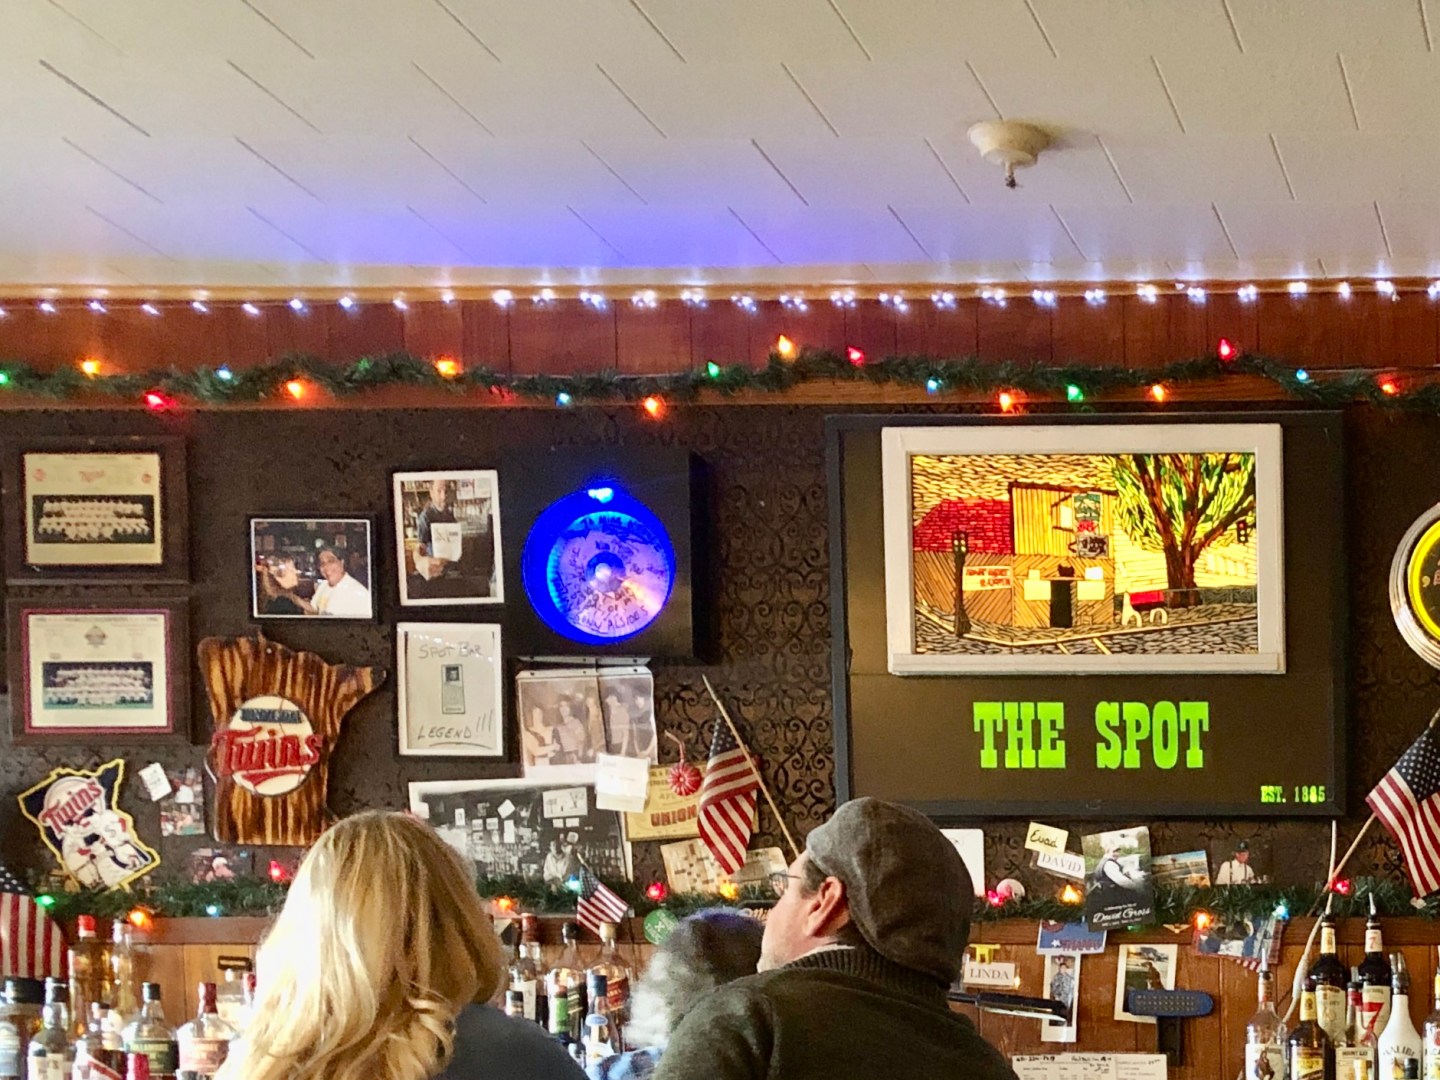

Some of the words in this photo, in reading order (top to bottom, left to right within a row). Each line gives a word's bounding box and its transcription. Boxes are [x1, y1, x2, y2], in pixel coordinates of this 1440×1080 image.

[212, 726, 323, 778] Twins
[973, 702, 1066, 769] THE
[1095, 700, 1210, 770] SPOT
[39, 780, 103, 834] Twins
[1260, 785, 1287, 804] EST.
[1042, 853, 1082, 873] DAVID
[970, 969, 1010, 980] LINDA
